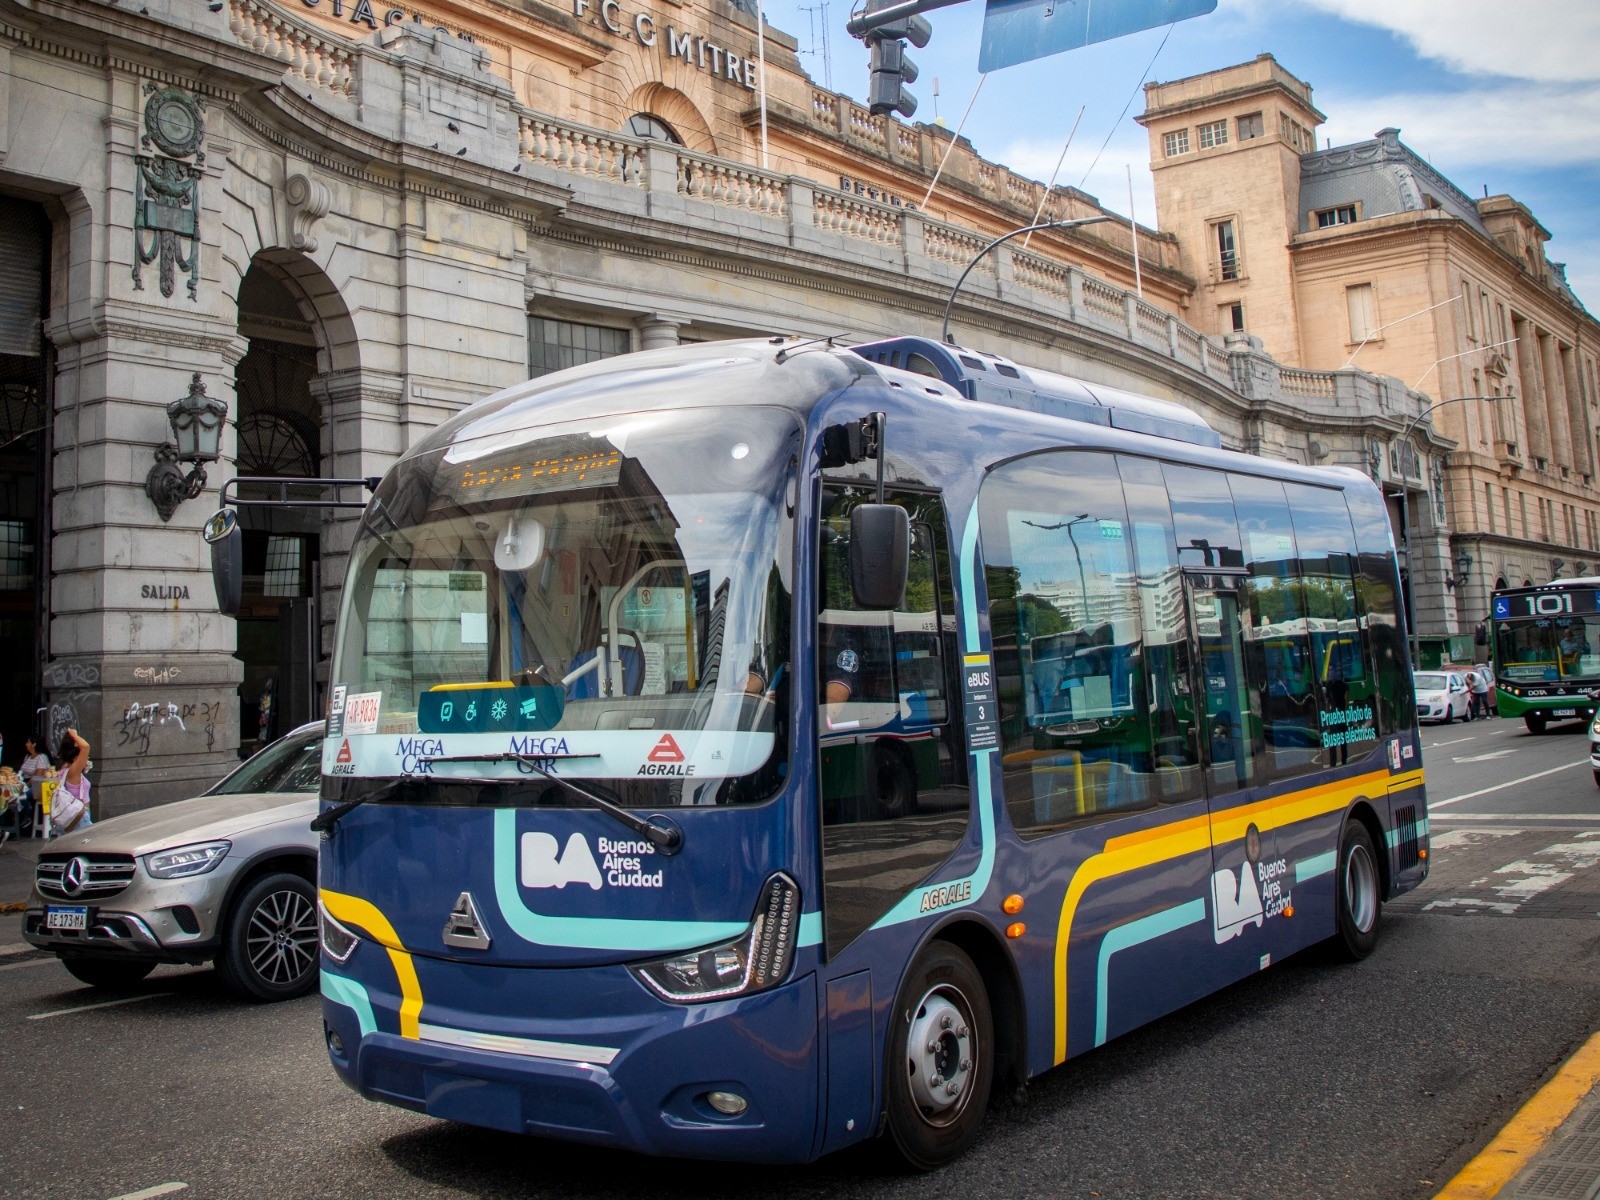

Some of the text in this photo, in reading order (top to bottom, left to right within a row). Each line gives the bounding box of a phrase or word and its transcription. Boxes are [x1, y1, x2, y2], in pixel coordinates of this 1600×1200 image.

[667, 25, 758, 91] MITRE
[141, 585, 190, 600] SALIDA
[1526, 594, 1573, 615] 101
[967, 671, 990, 687] eBUS
[978, 705, 985, 720] 3
[1320, 704, 1373, 727] Prueba piloto de
[395, 737, 445, 756] MEGA
[508, 735, 570, 755] MEGA
[1322, 731, 1345, 749] Buses
[331, 764, 356, 775] AGRALE
[401, 754, 435, 774] CAR
[637, 764, 696, 776] AGRALE
[598, 837, 655, 854] Buenos
[521, 831, 603, 891] BA
[602, 853, 641, 870] Aires
[1258, 858, 1286, 881] Buenos
[607, 870, 664, 888] Ciudad
[920, 880, 971, 913] AGRALE
[1262, 879, 1281, 901] Aires
[49, 914, 57, 926] AE
[60, 914, 73, 926] 173
